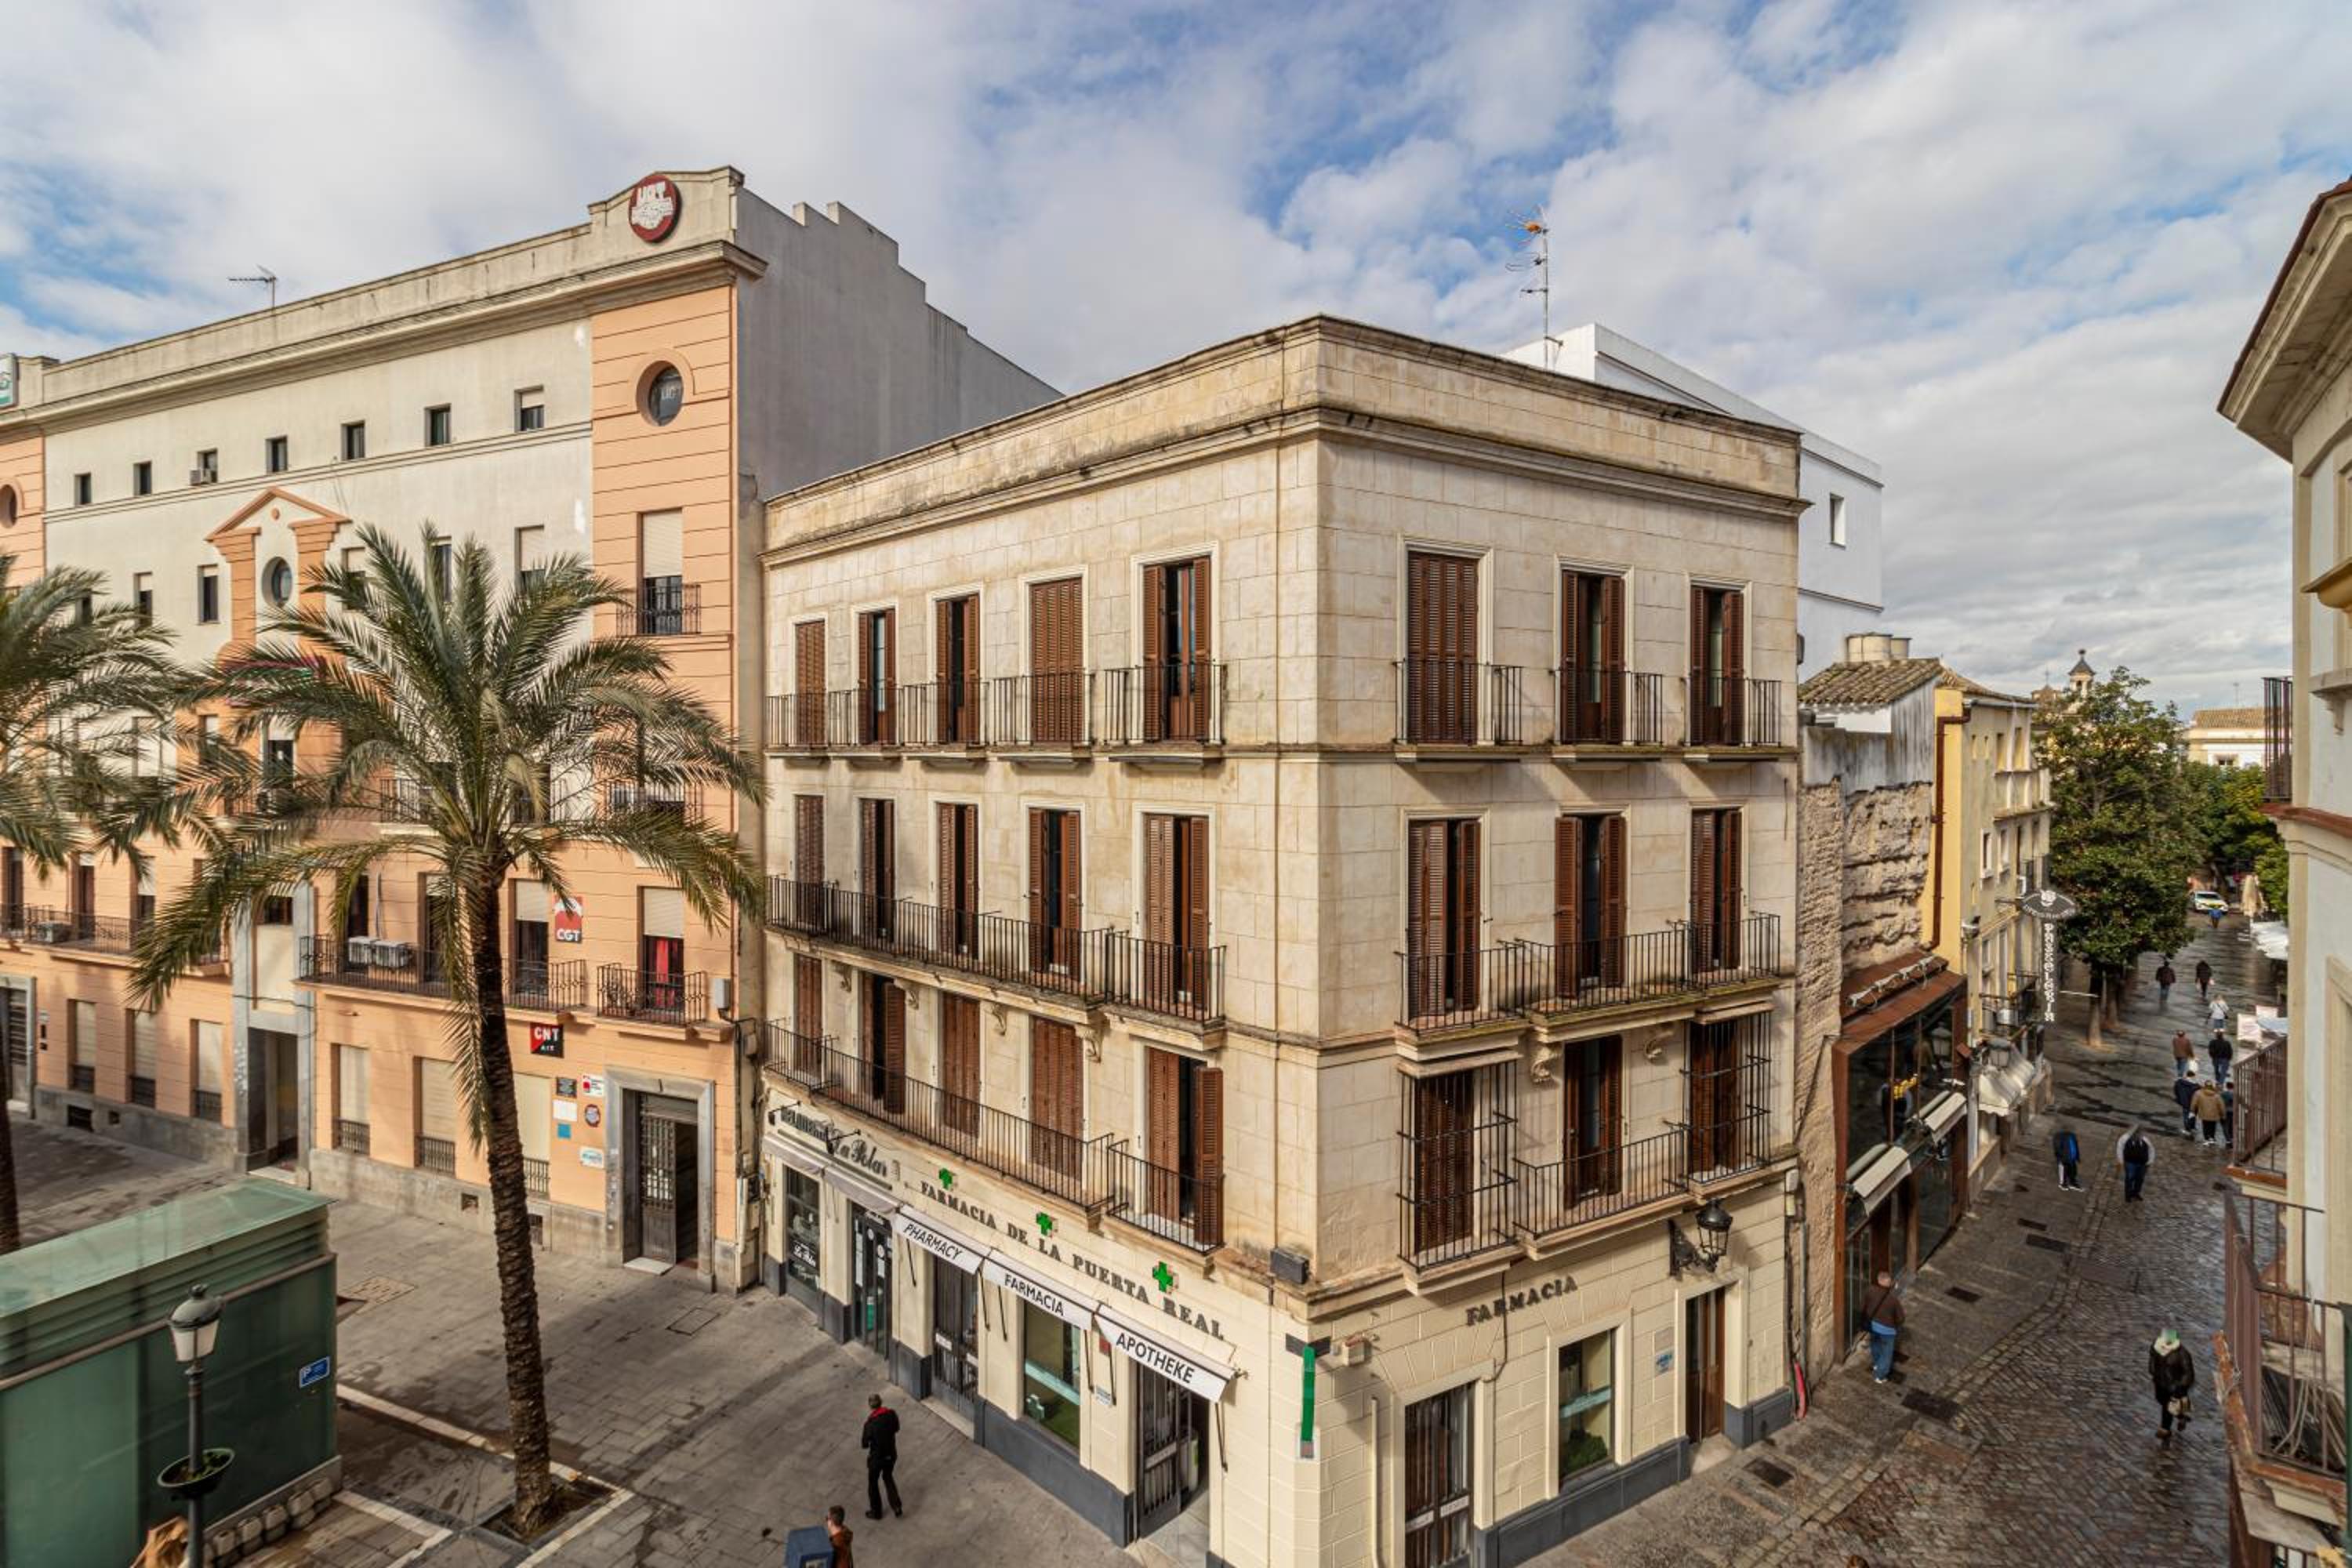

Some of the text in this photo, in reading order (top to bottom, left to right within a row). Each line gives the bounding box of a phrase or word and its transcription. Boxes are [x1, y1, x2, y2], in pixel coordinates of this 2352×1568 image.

[557, 928, 580, 942] CGT
[534, 1026, 559, 1041] CNT
[903, 1223, 962, 1260] PHARMACY
[920, 1180, 1224, 1341] FARMACIA DE LA PUERTA REAL
[1004, 1274, 1064, 1316] FARMACIA
[1465, 1275, 1578, 1327] FARMACIA
[1116, 1333, 1195, 1384] APOTHEKE
